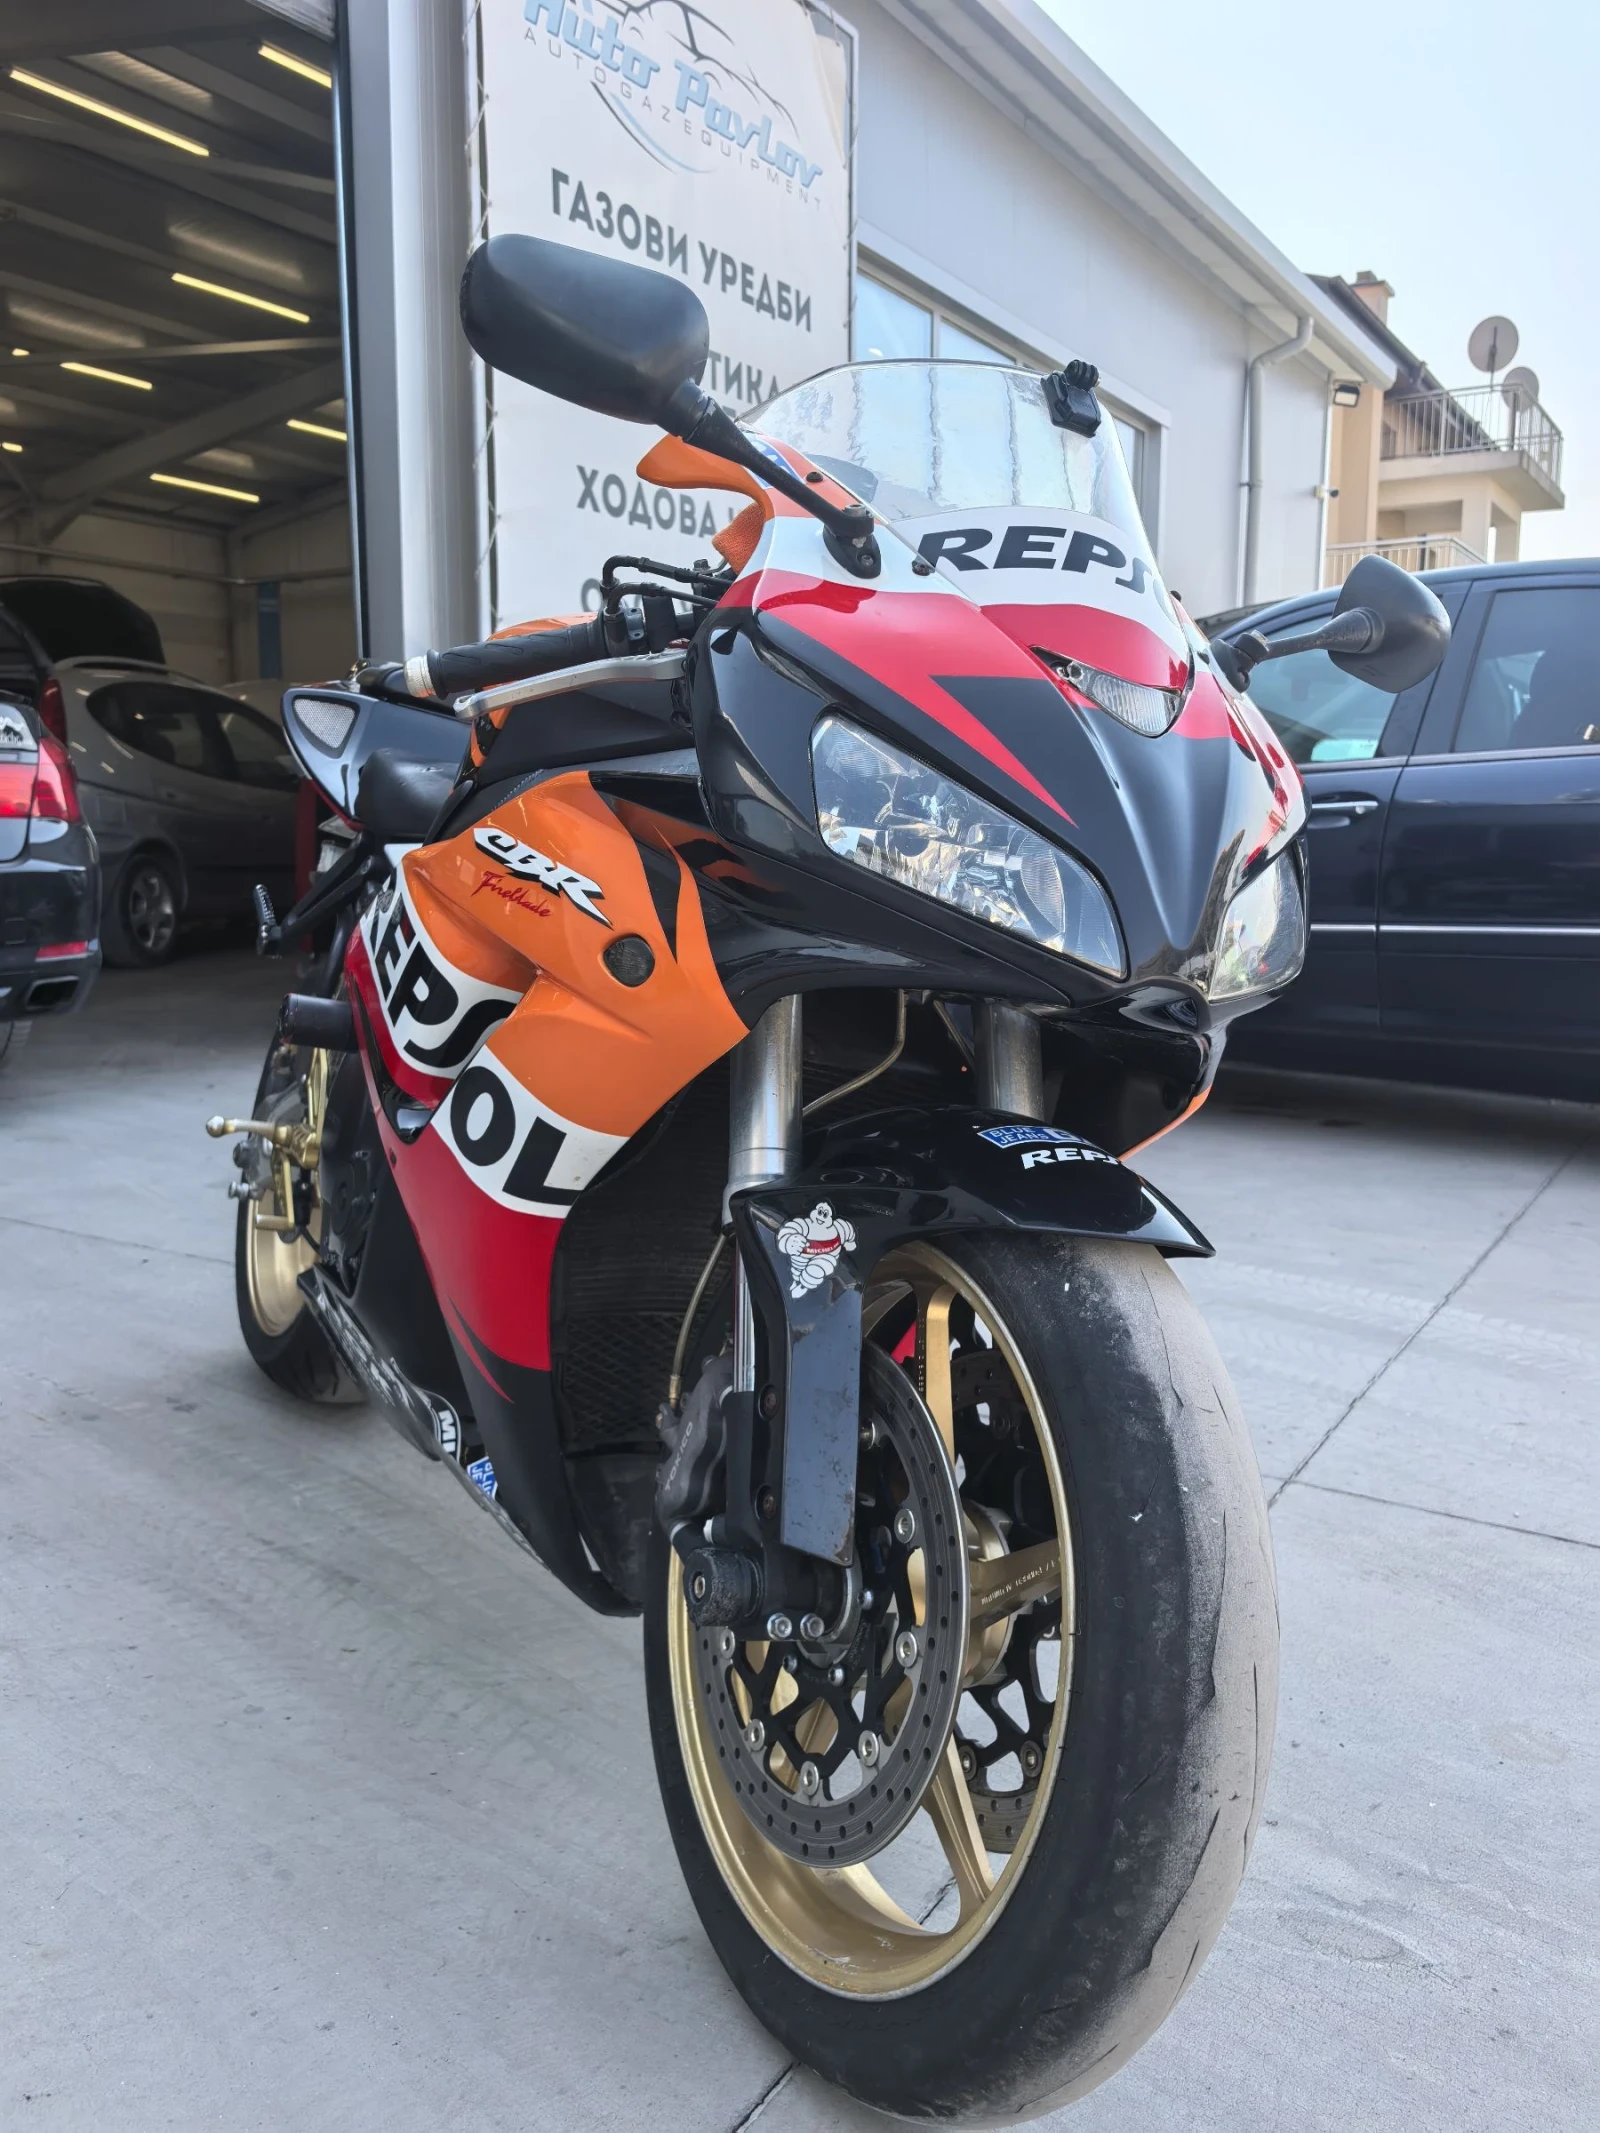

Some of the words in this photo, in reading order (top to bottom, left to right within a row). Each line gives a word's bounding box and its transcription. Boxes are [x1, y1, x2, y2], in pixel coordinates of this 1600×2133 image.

[674, 59, 823, 189] Pavlov
[551, 167, 688, 275] ГАЗОВИ
[698, 240, 812, 331] УРЕДБИ
[576, 464, 717, 539] ХОДОВА
[917, 525, 1176, 624] REPS
[473, 827, 615, 932] CBR
[989, 1127, 1036, 1138] BLUE
[1000, 1133, 1049, 1144] JEANS
[664, 1421, 693, 1492] TOKICO
